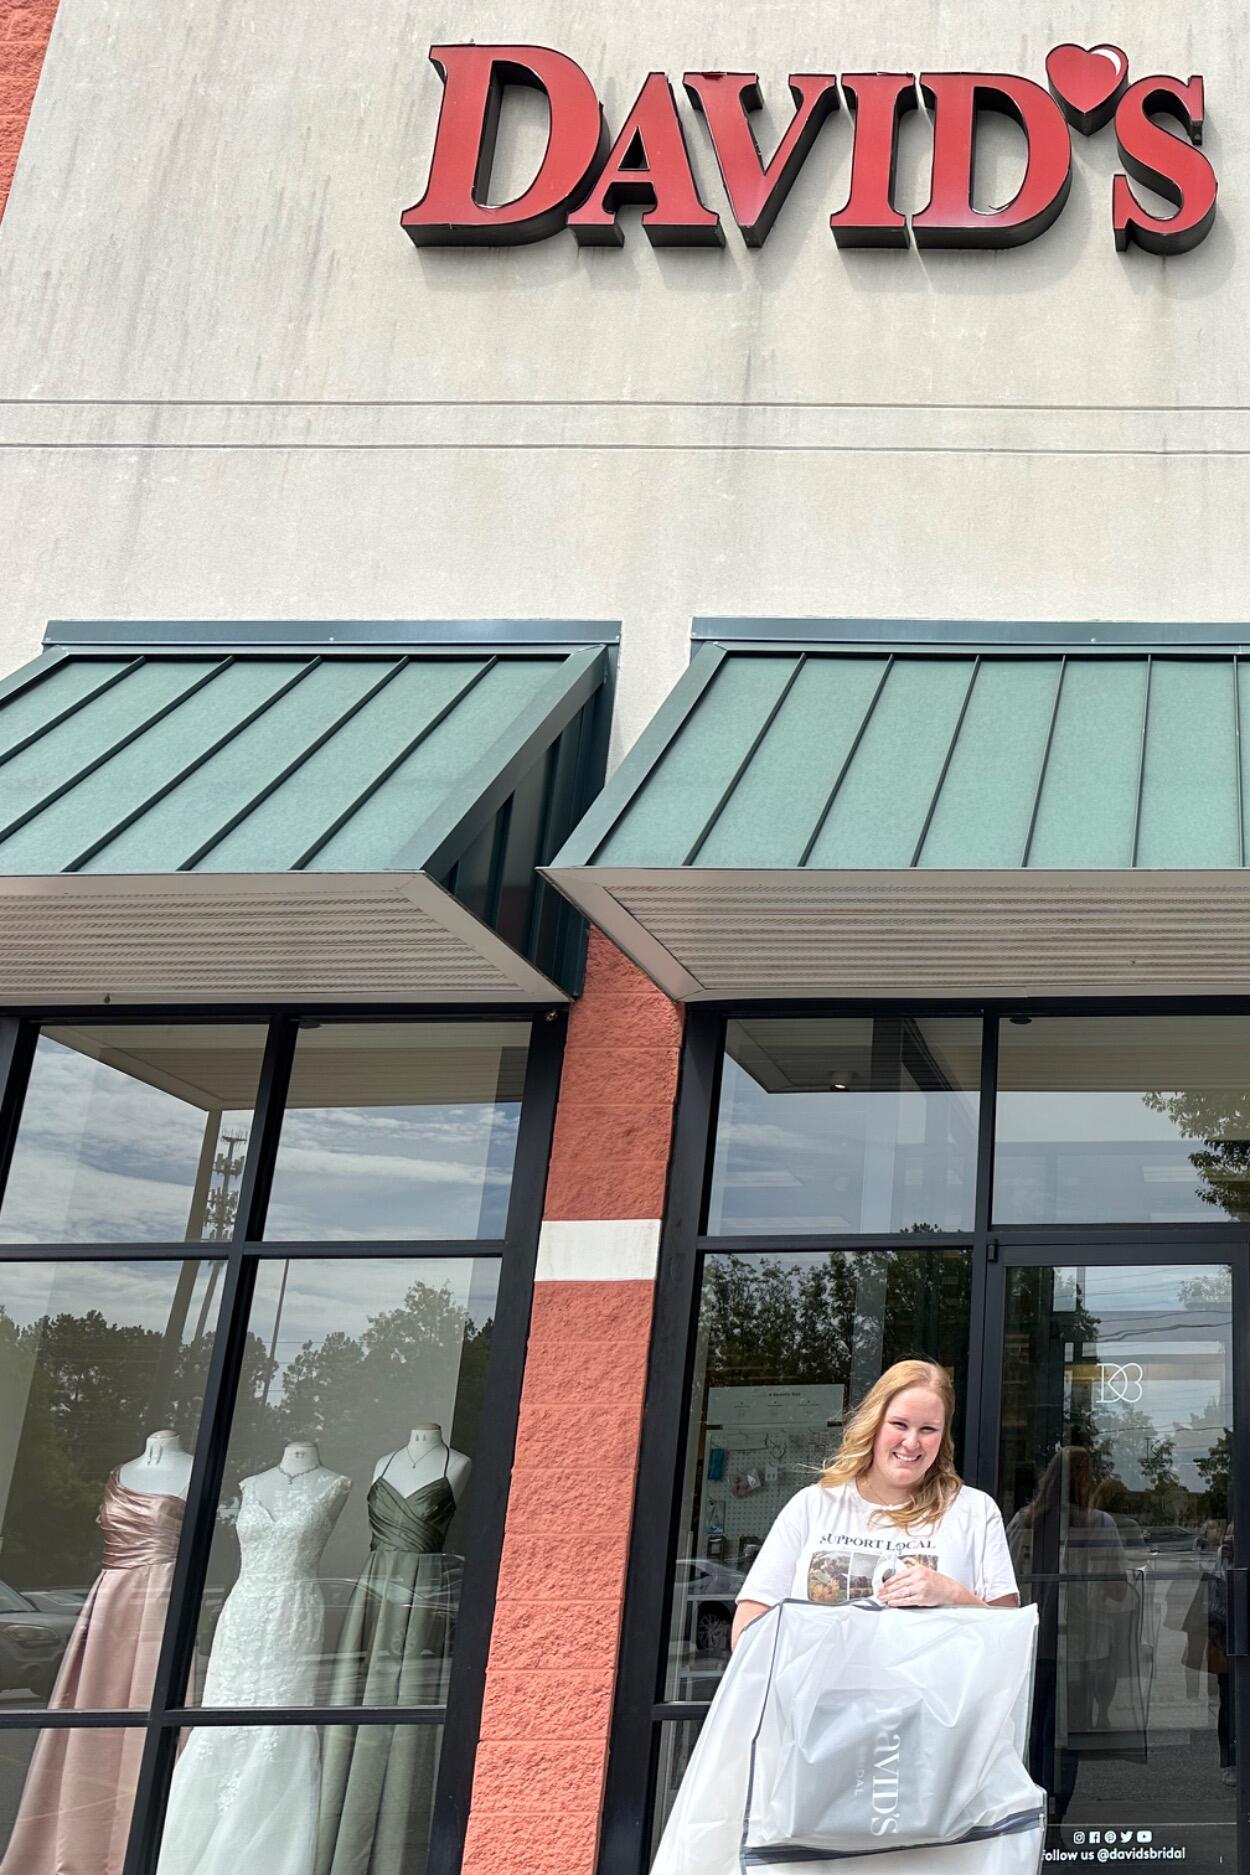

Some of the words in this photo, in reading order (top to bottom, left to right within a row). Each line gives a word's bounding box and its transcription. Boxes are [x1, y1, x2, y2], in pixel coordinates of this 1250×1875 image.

[401, 44, 1218, 255] DAVID'S
[819, 1533, 884, 1549] SUPPORT
[1081, 1850, 1095, 1860] us
[1097, 1846, 1186, 1863] @davidsbridal
